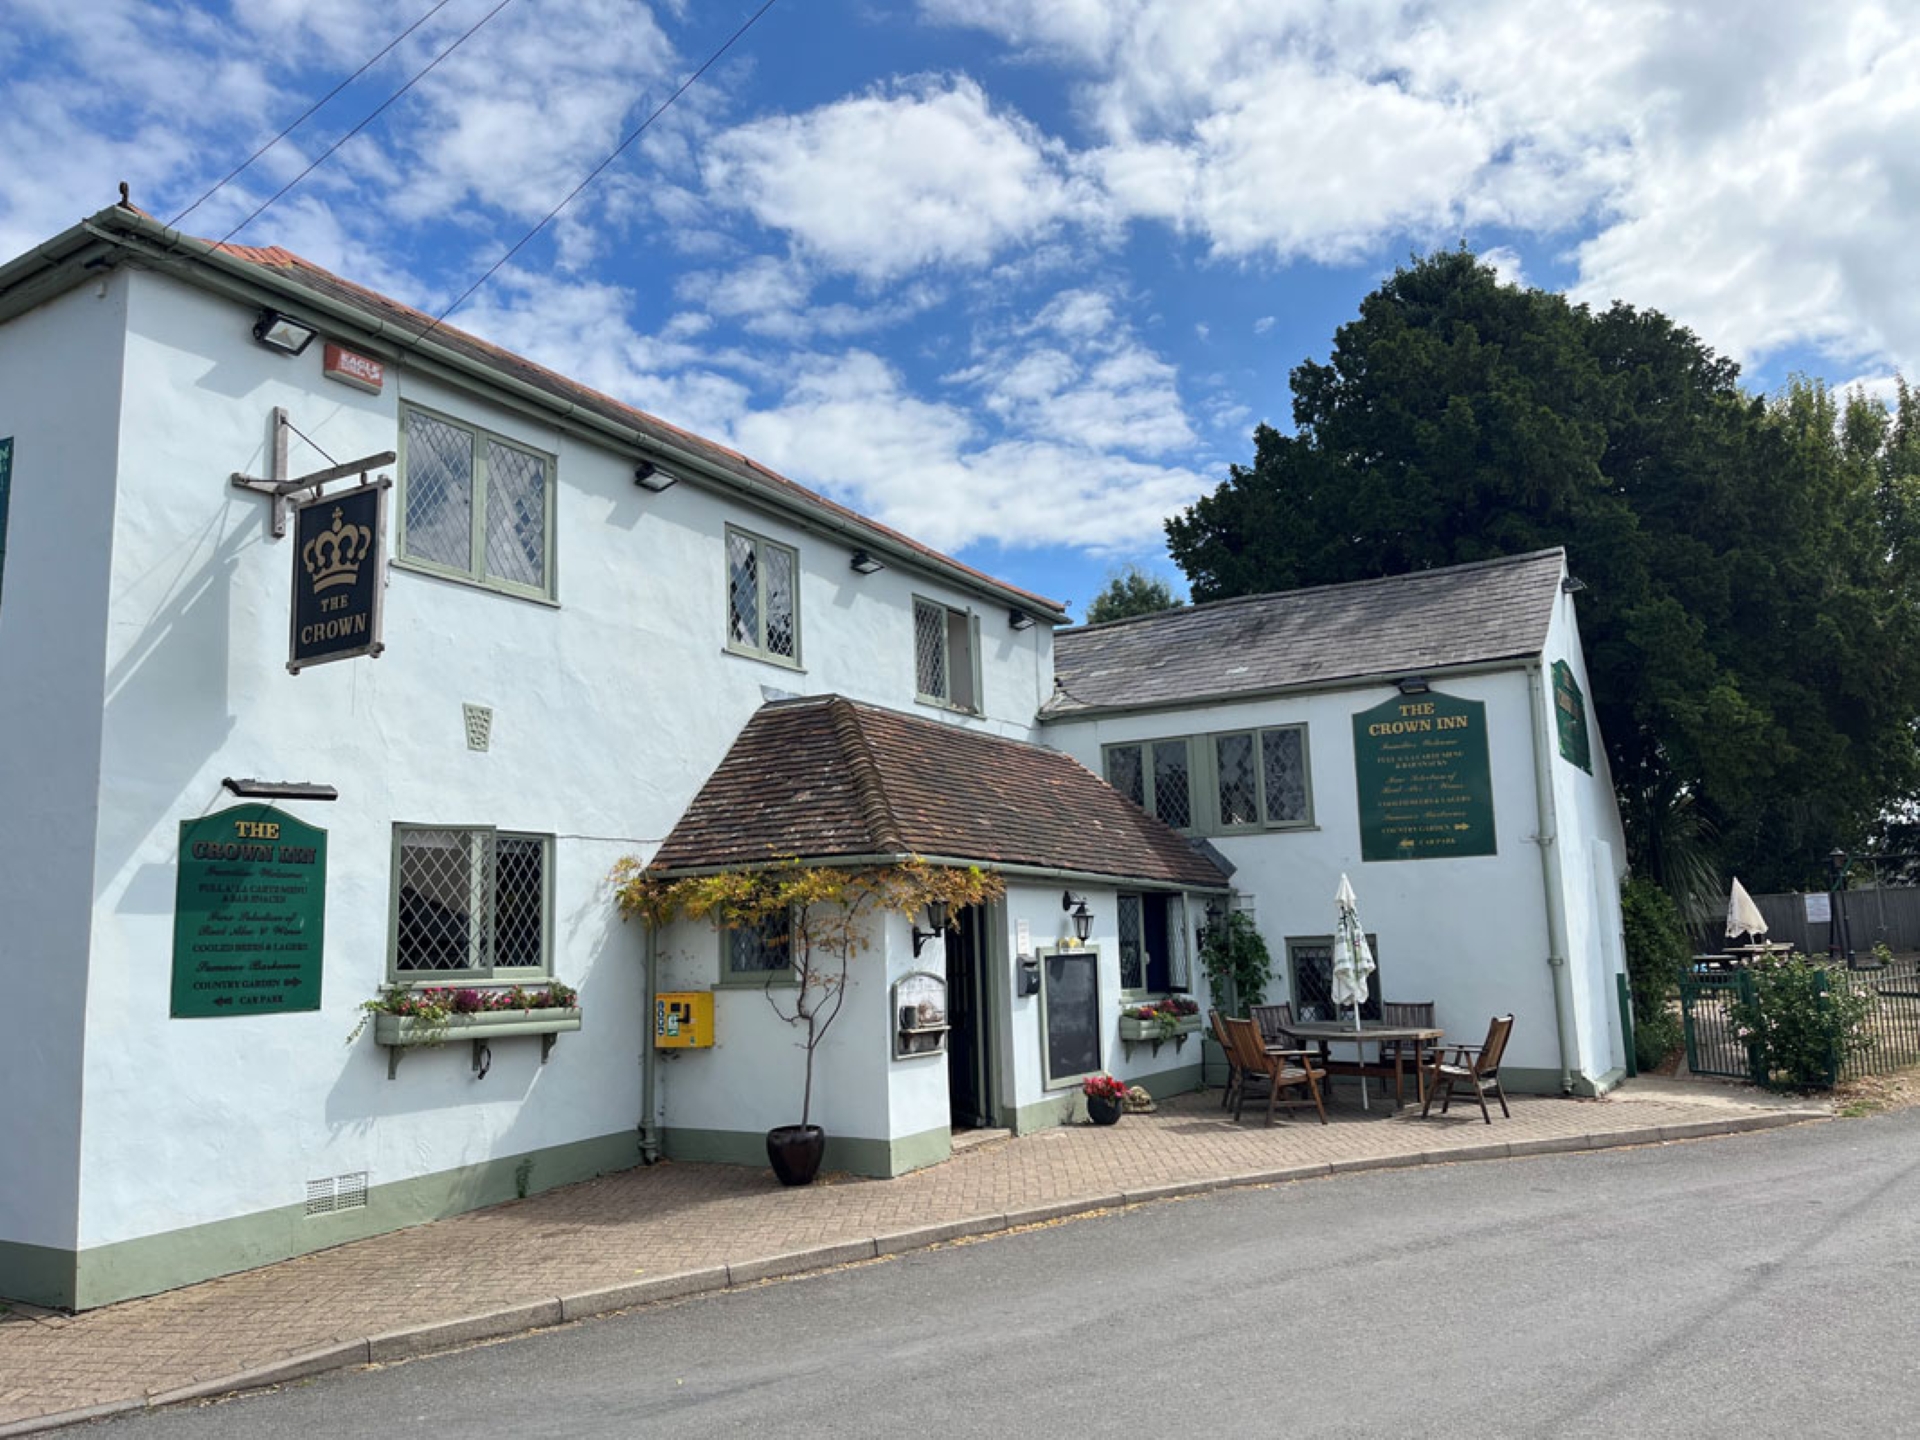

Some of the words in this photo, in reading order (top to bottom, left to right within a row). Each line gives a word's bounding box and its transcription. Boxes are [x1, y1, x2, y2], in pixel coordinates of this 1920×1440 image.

[321, 594, 349, 612] THE
[301, 612, 367, 644] CROWN
[1399, 702, 1434, 716] THE
[1368, 719, 1431, 737] CROWN
[1436, 715, 1468, 730] INN
[235, 821, 279, 839] THE
[192, 841, 274, 862] CROWN
[278, 845, 317, 864] INN
[193, 980, 240, 991] COUNTRY
[242, 979, 280, 989] GARDEN
[239, 996, 258, 1005] CAR
[259, 994, 283, 1004] PARK
